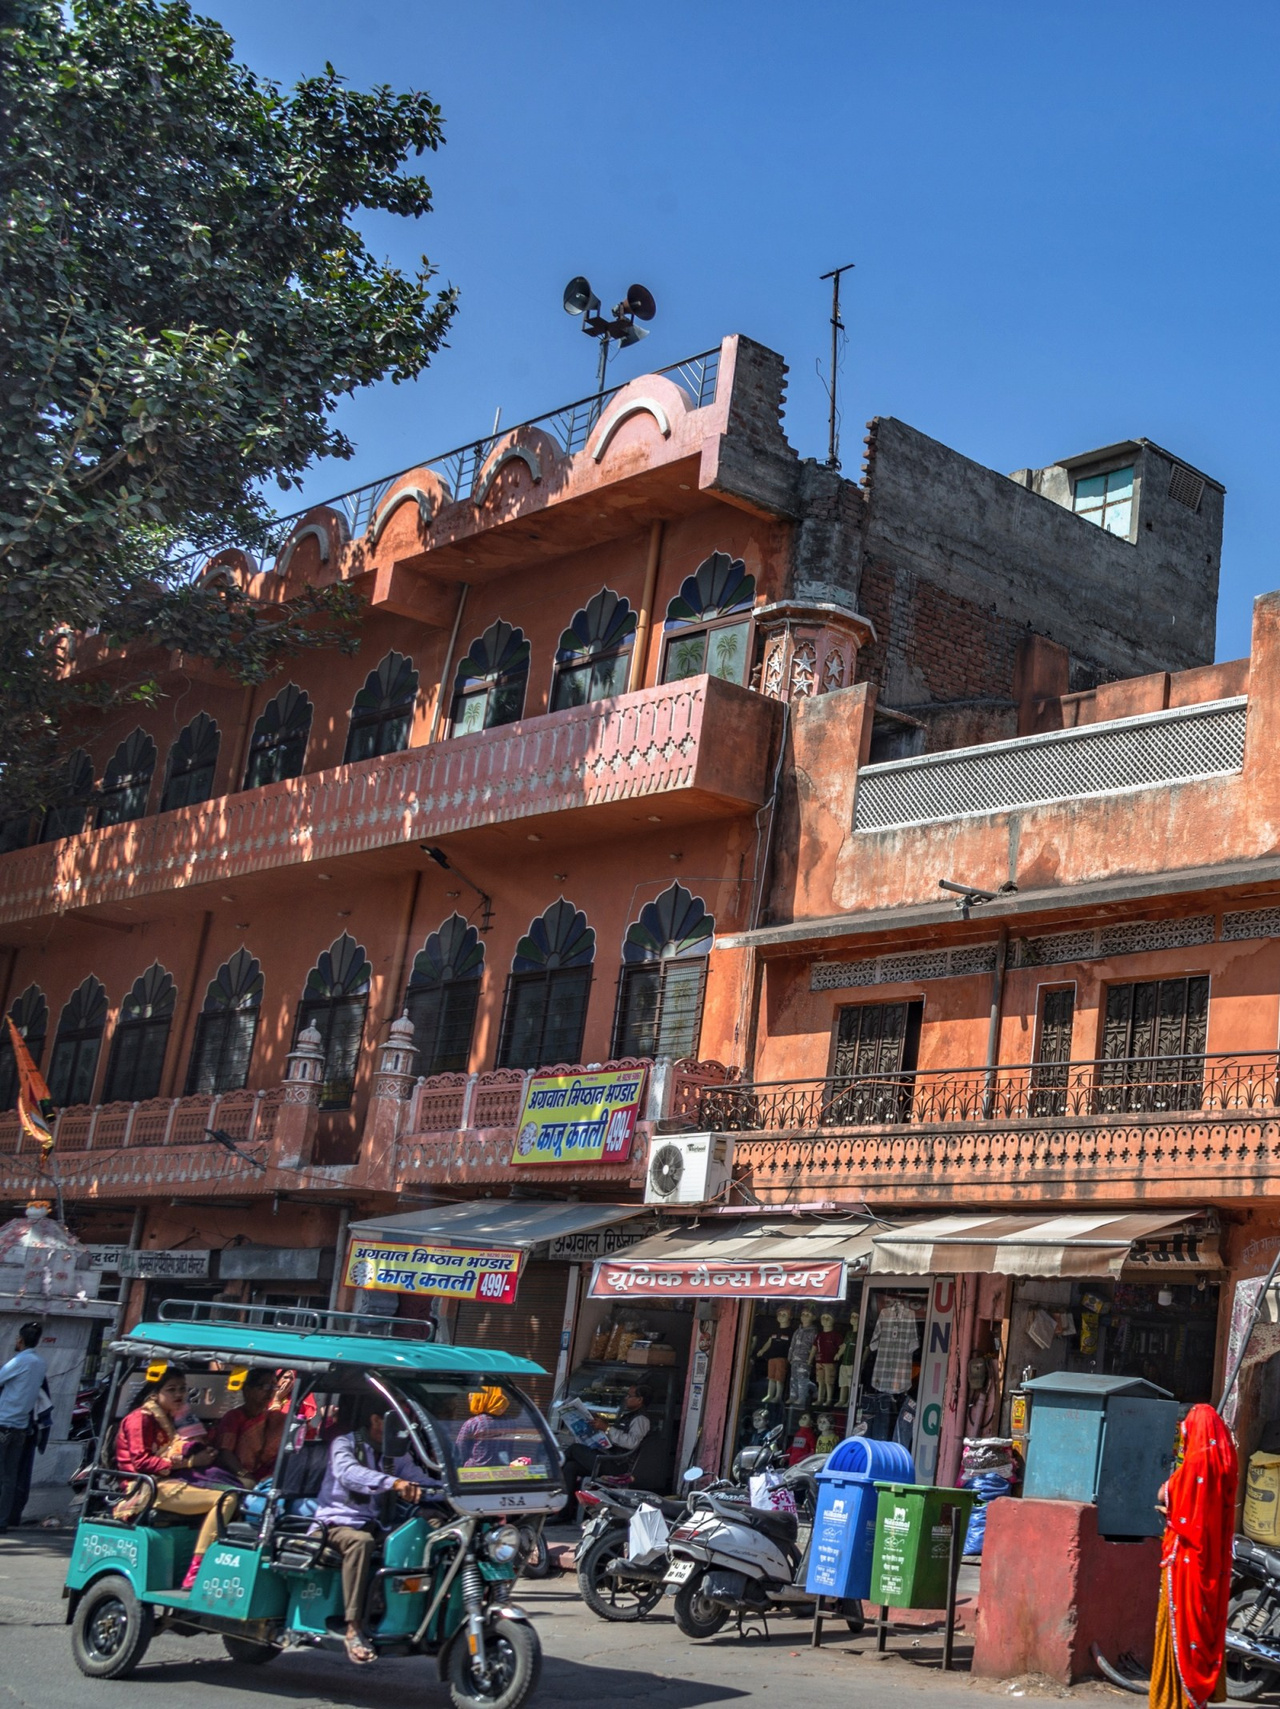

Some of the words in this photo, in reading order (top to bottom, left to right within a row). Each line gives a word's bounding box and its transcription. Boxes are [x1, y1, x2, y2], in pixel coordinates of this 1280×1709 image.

[528, 1089, 568, 1109] अग्रवाल
[567, 1080, 606, 1107] मिष्ठान
[605, 1082, 639, 1103] भण्डार
[536, 1122, 568, 1158] काजू
[566, 1108, 609, 1149] कतली
[606, 1111, 631, 1152] 499/-
[553, 1233, 600, 1253] अग्रवाल
[104, 1250, 119, 1263] स्टो
[355, 1248, 409, 1263] अग्रवाल
[411, 1248, 465, 1267] मिष्ठान
[467, 1257, 514, 1270] भण्डार
[377, 1268, 418, 1290] काजू
[419, 1270, 477, 1291] कतली
[480, 1273, 510, 1297] 499/-
[607, 1265, 683, 1291] यूनिक
[690, 1264, 754, 1288] मैन्स
[757, 1264, 829, 1288] वियर
[918, 1282, 953, 1478] UNIQU
[500, 1496, 526, 1506] JSA
[214, 1553, 240, 1567] JSA
